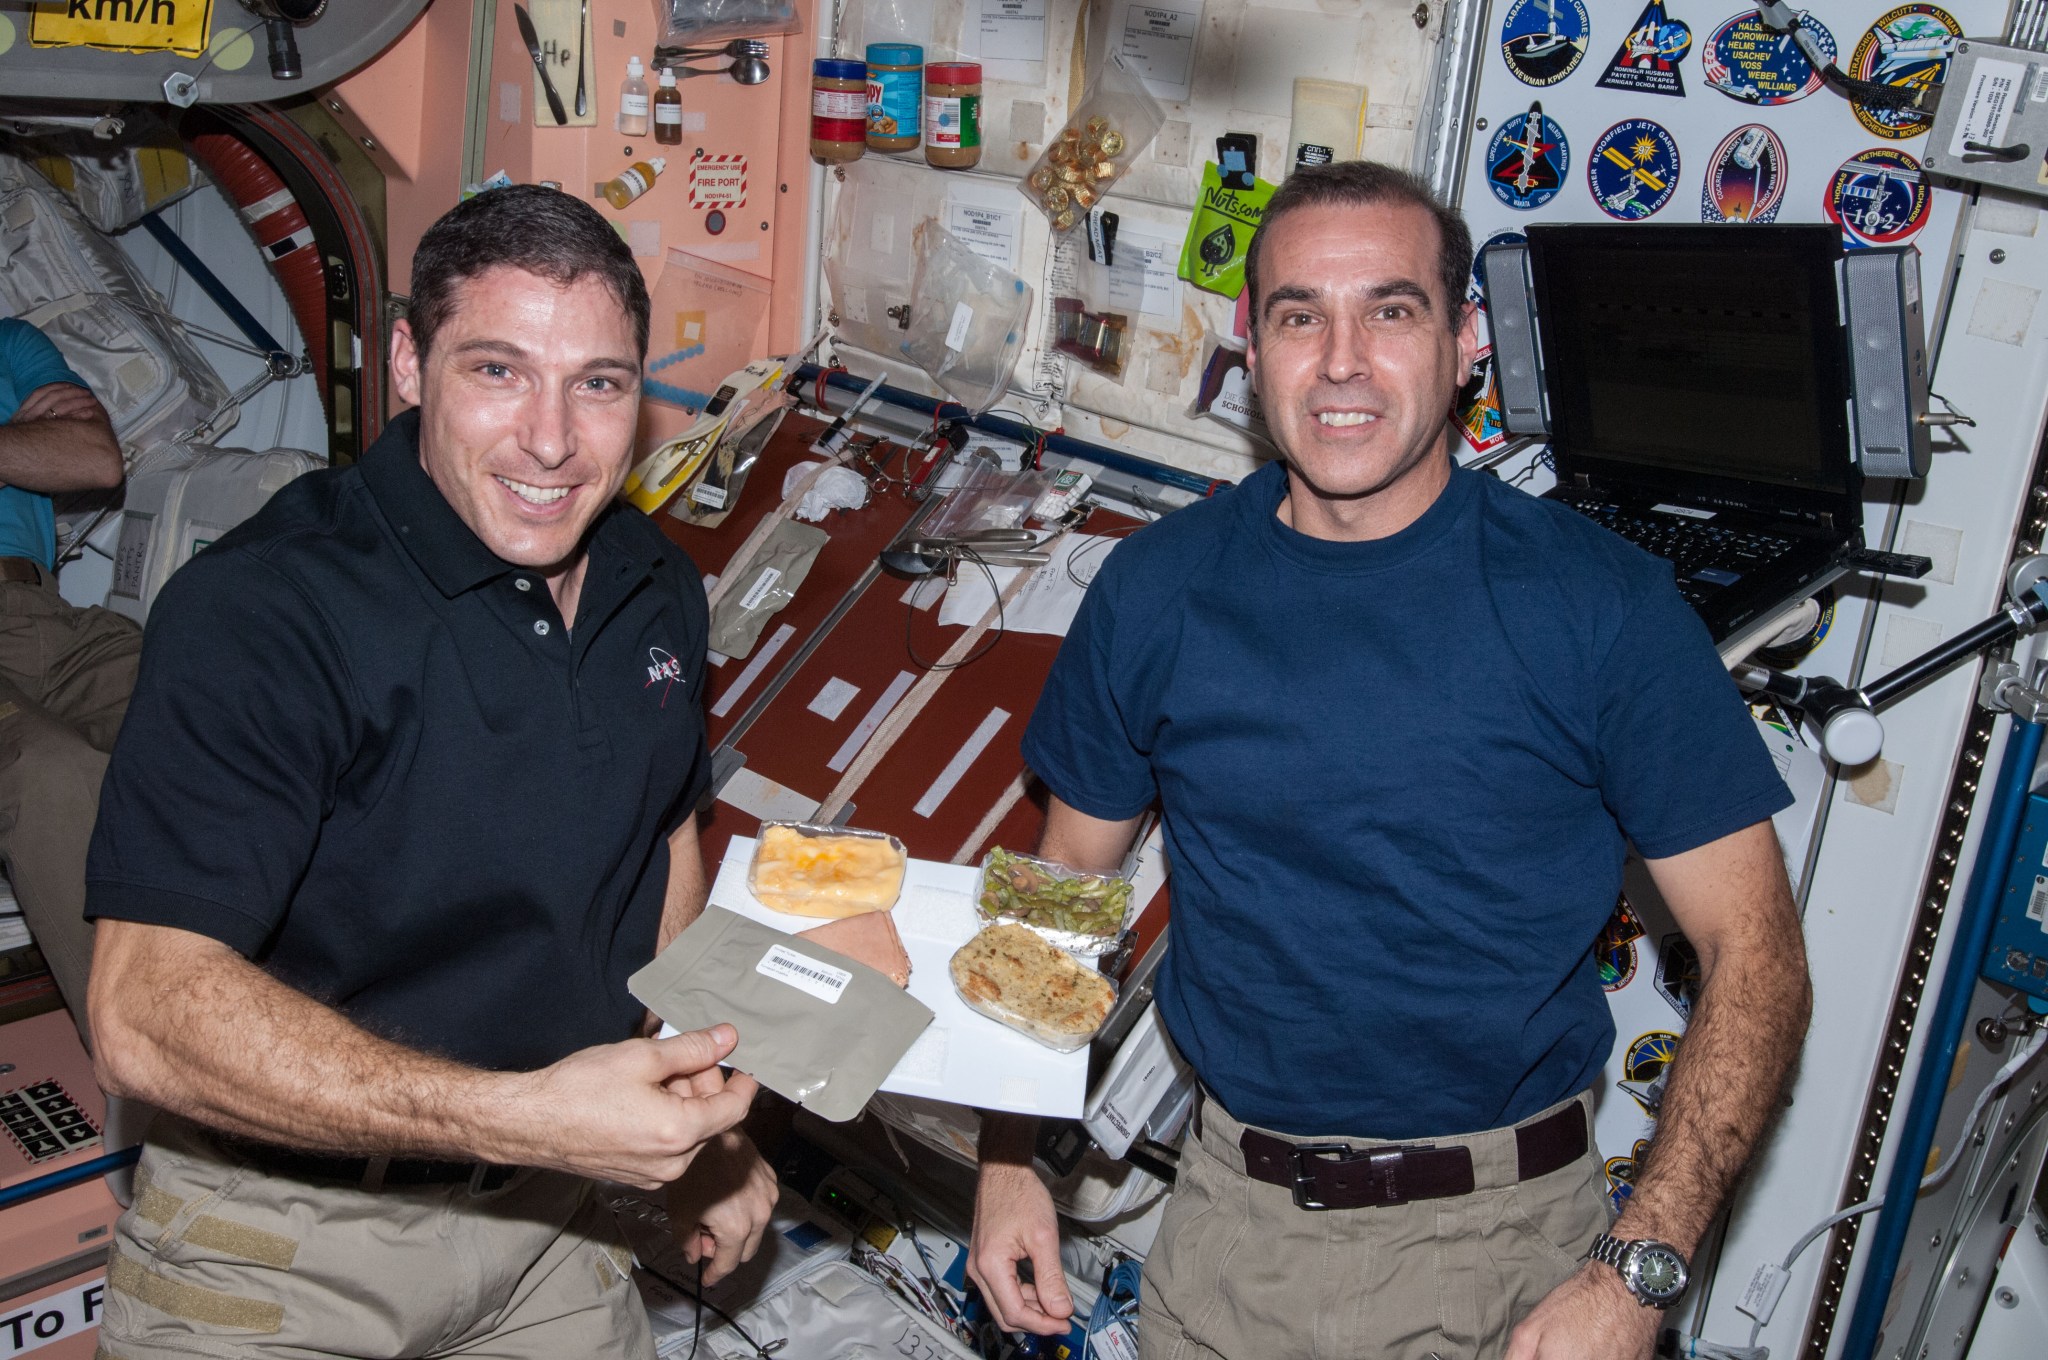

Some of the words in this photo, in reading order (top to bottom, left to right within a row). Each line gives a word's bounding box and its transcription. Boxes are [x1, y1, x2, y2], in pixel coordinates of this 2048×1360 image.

[67, 0, 176, 26] km/h
[1573, 1, 1589, 33] CURRIE
[1877, 5, 1914, 28] WILCUTT
[1934, 9, 1961, 36] ALTMAN
[1727, 41, 1756, 50] HELMS
[1732, 51, 1771, 61] USACHEV
[1849, 32, 1874, 79] STRACCHIO
[1503, 45, 1516, 69] ROSS
[1514, 67, 1545, 86] NEWMAN
[1611, 72, 1638, 80] PAYETTE
[1645, 70, 1674, 78] HUSBAND
[1740, 61, 1762, 70] VOSS
[1747, 71, 1778, 81] WEBER
[1605, 78, 1633, 86] JERNIGAN
[1635, 81, 1655, 89] OCHOA
[1658, 84, 1679, 92] BARRY
[1757, 81, 1797, 92] WILLIAMS
[1975, 74, 1987, 99] Firmware
[1997, 92, 2008, 113] Remote
[1637, 122, 1657, 132] JETT
[1853, 102, 1895, 138] ALENCHENKO
[1988, 113, 2001, 136] Sensing
[1592, 122, 1632, 163] BLOOMFIELD
[1638, 145, 1650, 155] 97
[1658, 131, 1678, 170] GARNEAU
[1716, 167, 1724, 200] COCKRELL
[1720, 136, 1742, 166] POLANSKY
[1766, 141, 1777, 172] CURBEAM
[1858, 150, 1899, 163] WETHERBEE
[1900, 156, 1918, 171] KELLY
[697, 178, 716, 187] FIRE
[717, 178, 740, 187] PORT
[1591, 168, 1605, 203] TANNER
[1650, 175, 1677, 210] NORIEGA
[1833, 172, 1848, 205] THOMAS
[1203, 186, 1264, 219] Nuts.com
[1756, 189, 1771, 209] JONES
[1908, 185, 1925, 223] RICHARDS
[131, 543, 144, 587] PANTRY
[1106, 1111, 1131, 1140] DISINFECTANT
[0, 1310, 65, 1350] To
[83, 1284, 105, 1323] F
